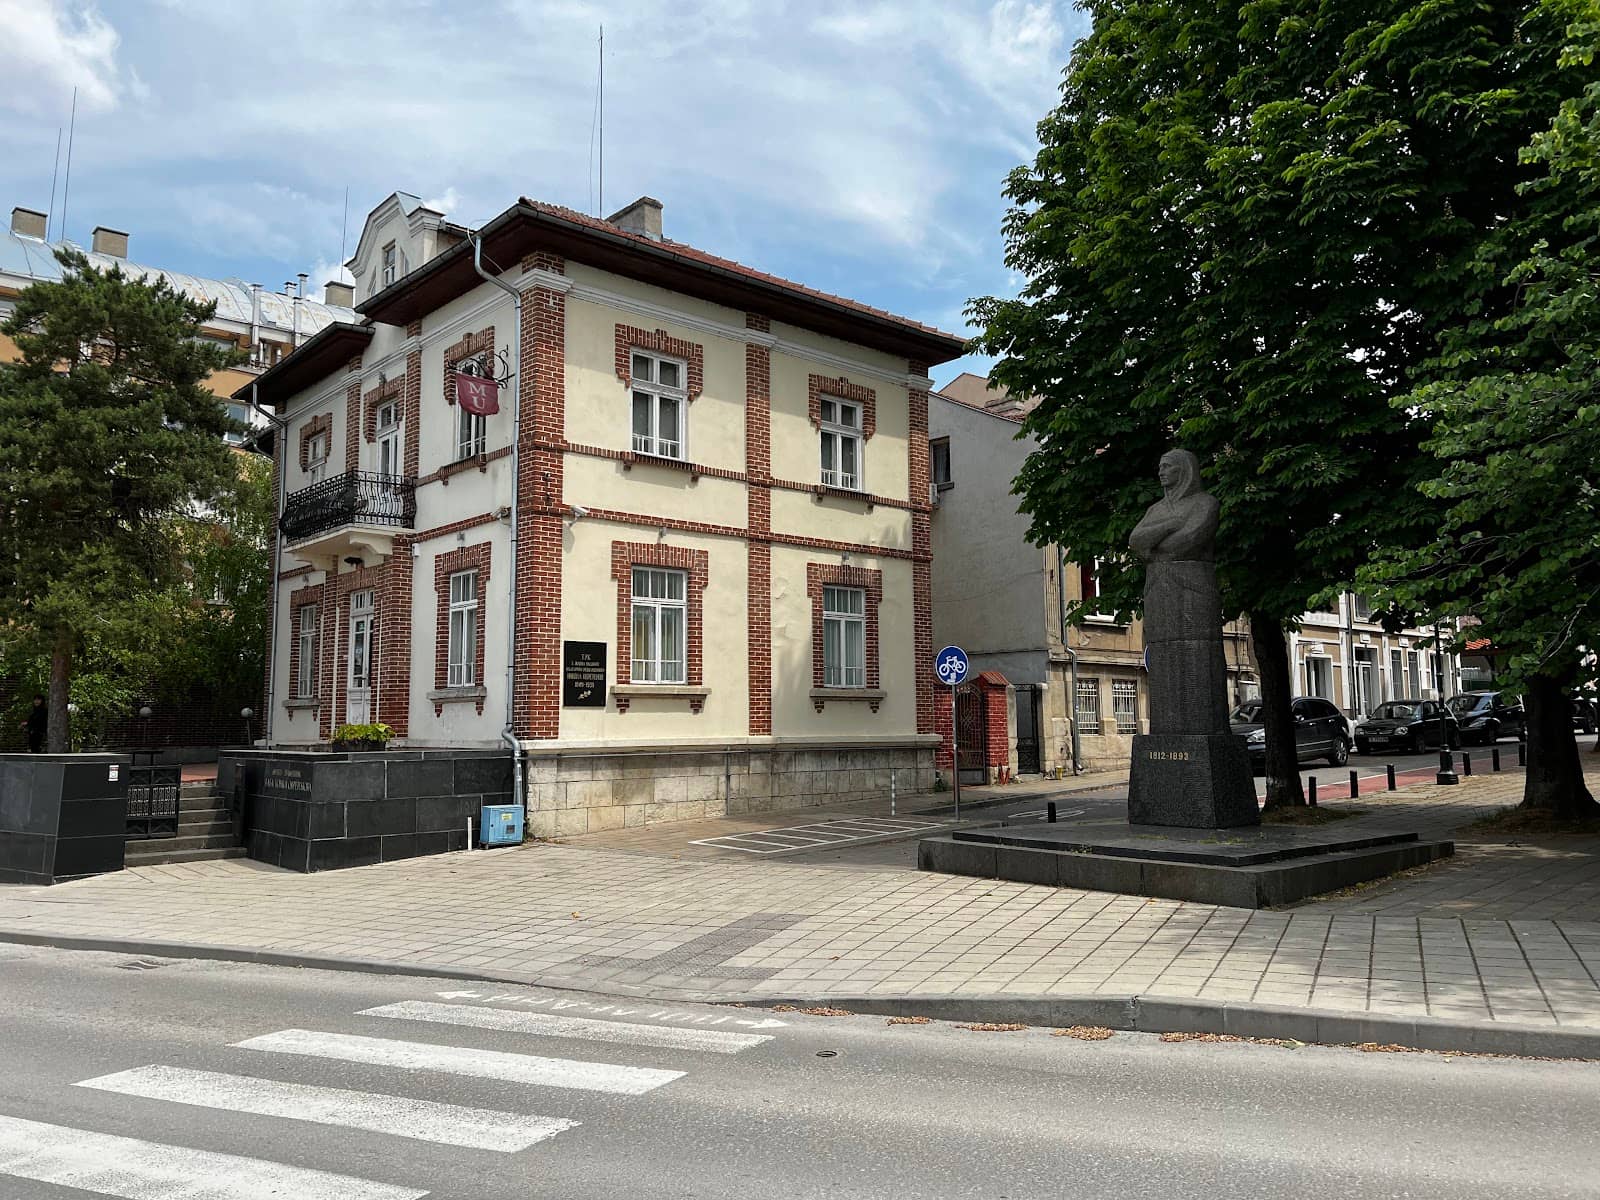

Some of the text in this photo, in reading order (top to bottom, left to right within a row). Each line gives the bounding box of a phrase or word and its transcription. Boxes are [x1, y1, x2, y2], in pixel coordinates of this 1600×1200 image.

[468, 381, 487, 397] M
[472, 396, 486, 409] U
[1150, 751, 1189, 760] 1812-1893
